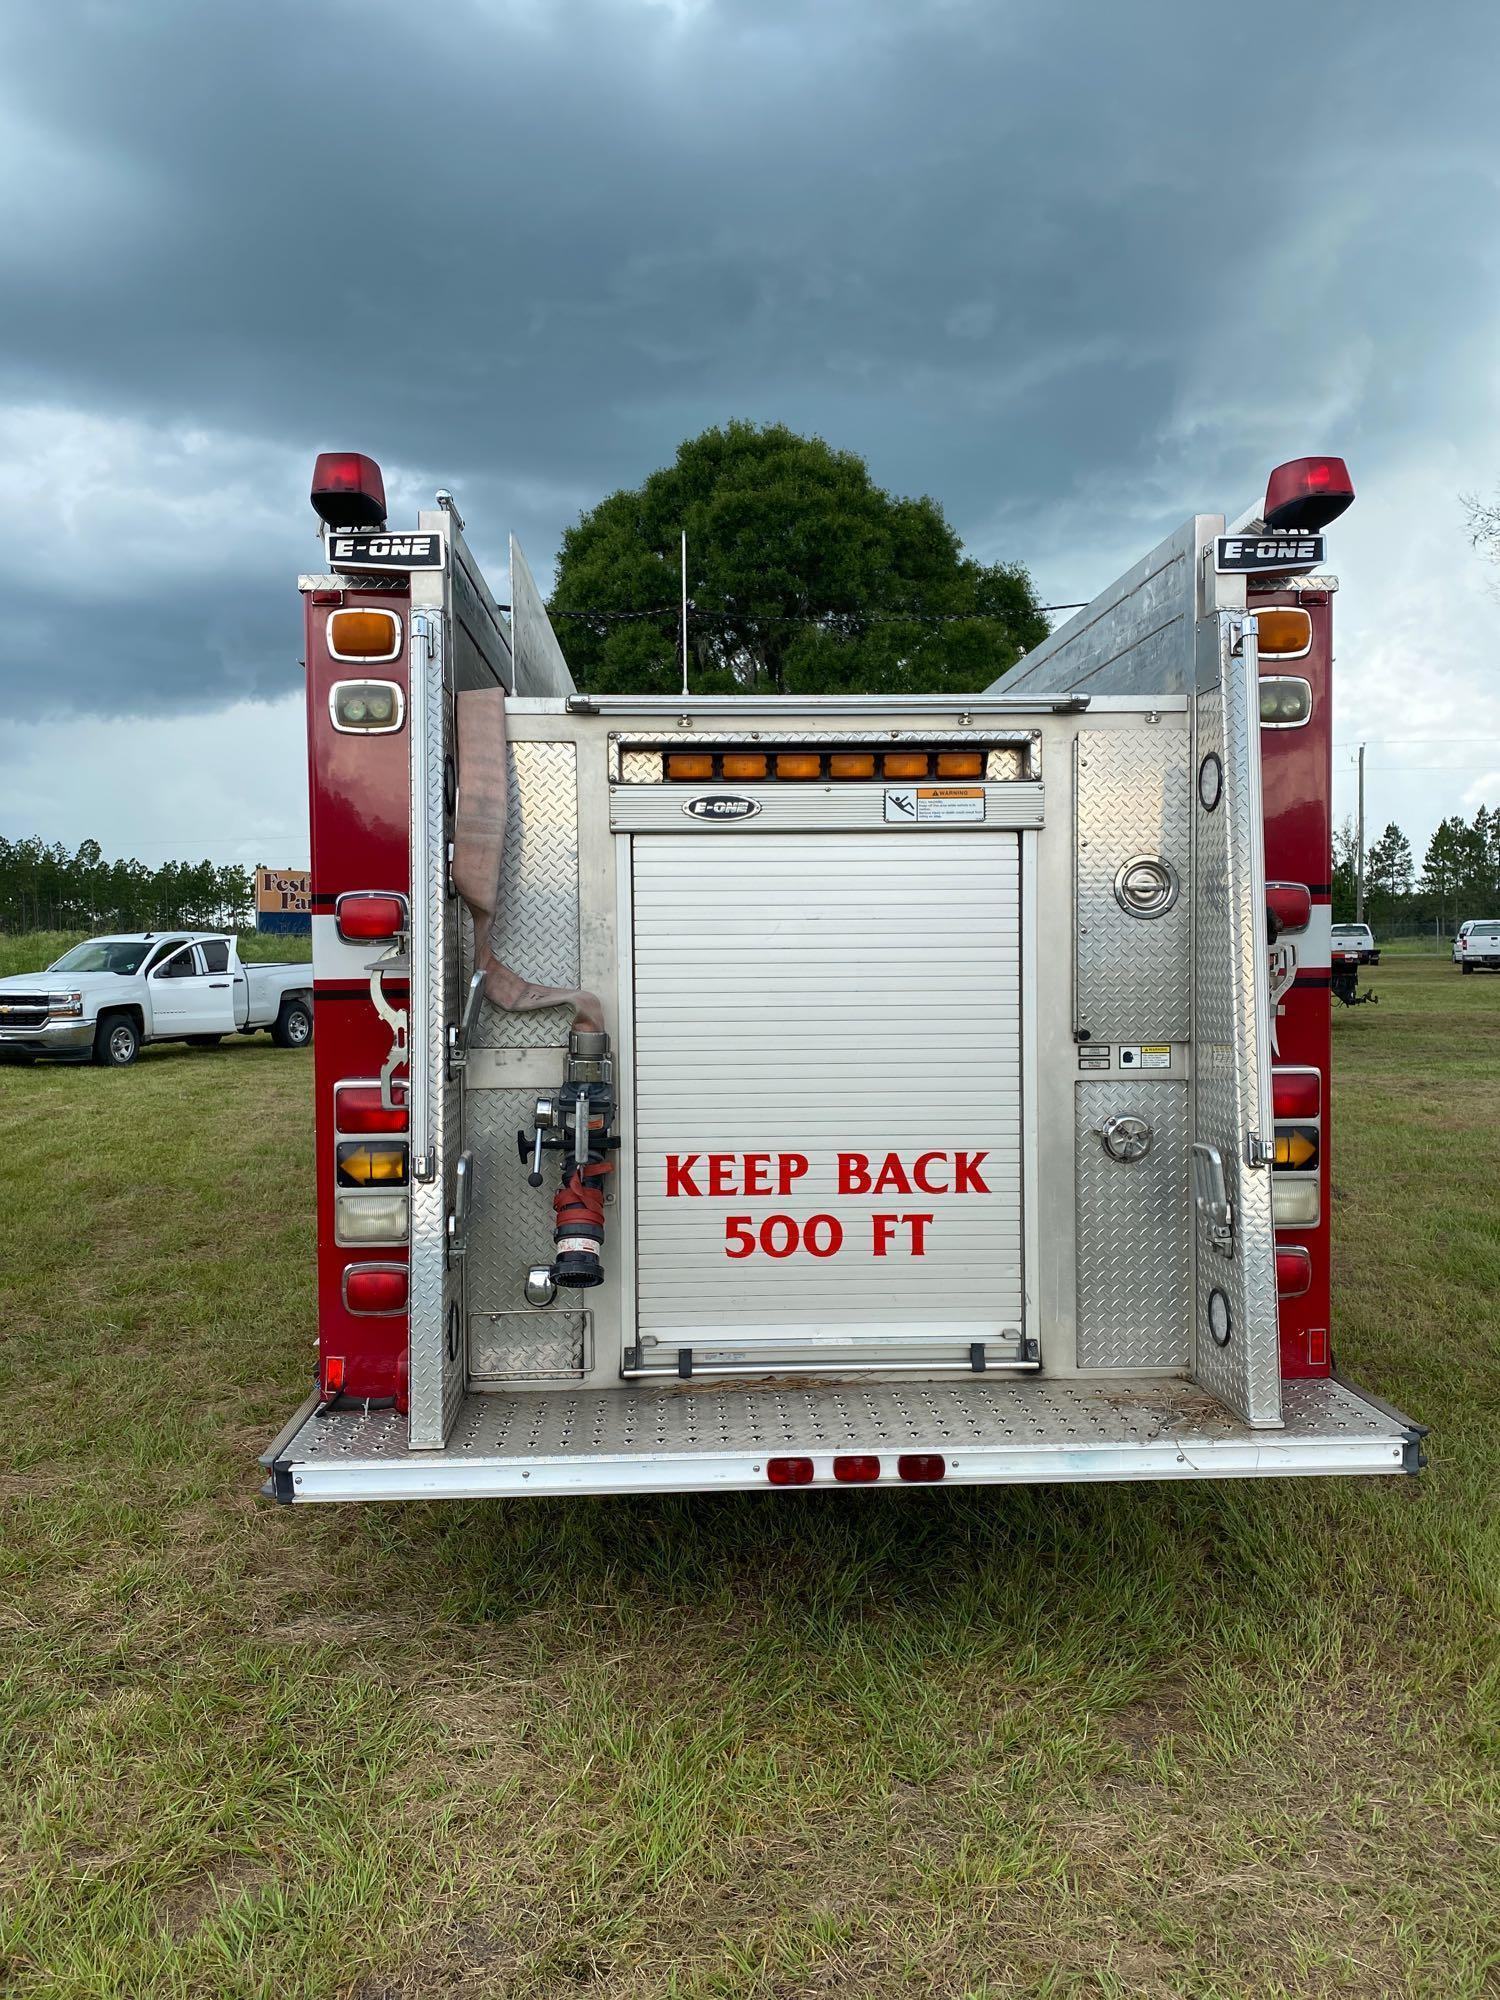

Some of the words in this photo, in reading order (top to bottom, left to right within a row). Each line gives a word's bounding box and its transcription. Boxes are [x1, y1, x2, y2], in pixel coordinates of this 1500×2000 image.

[335, 538, 431, 556] E-ONE
[1224, 541, 1315, 559] E-ONE
[694, 801, 749, 813] E-ONE
[666, 1154, 809, 1197] KEEP
[837, 1152, 992, 1195] BACK
[725, 1213, 844, 1258] 500
[872, 1214, 934, 1256] FT
